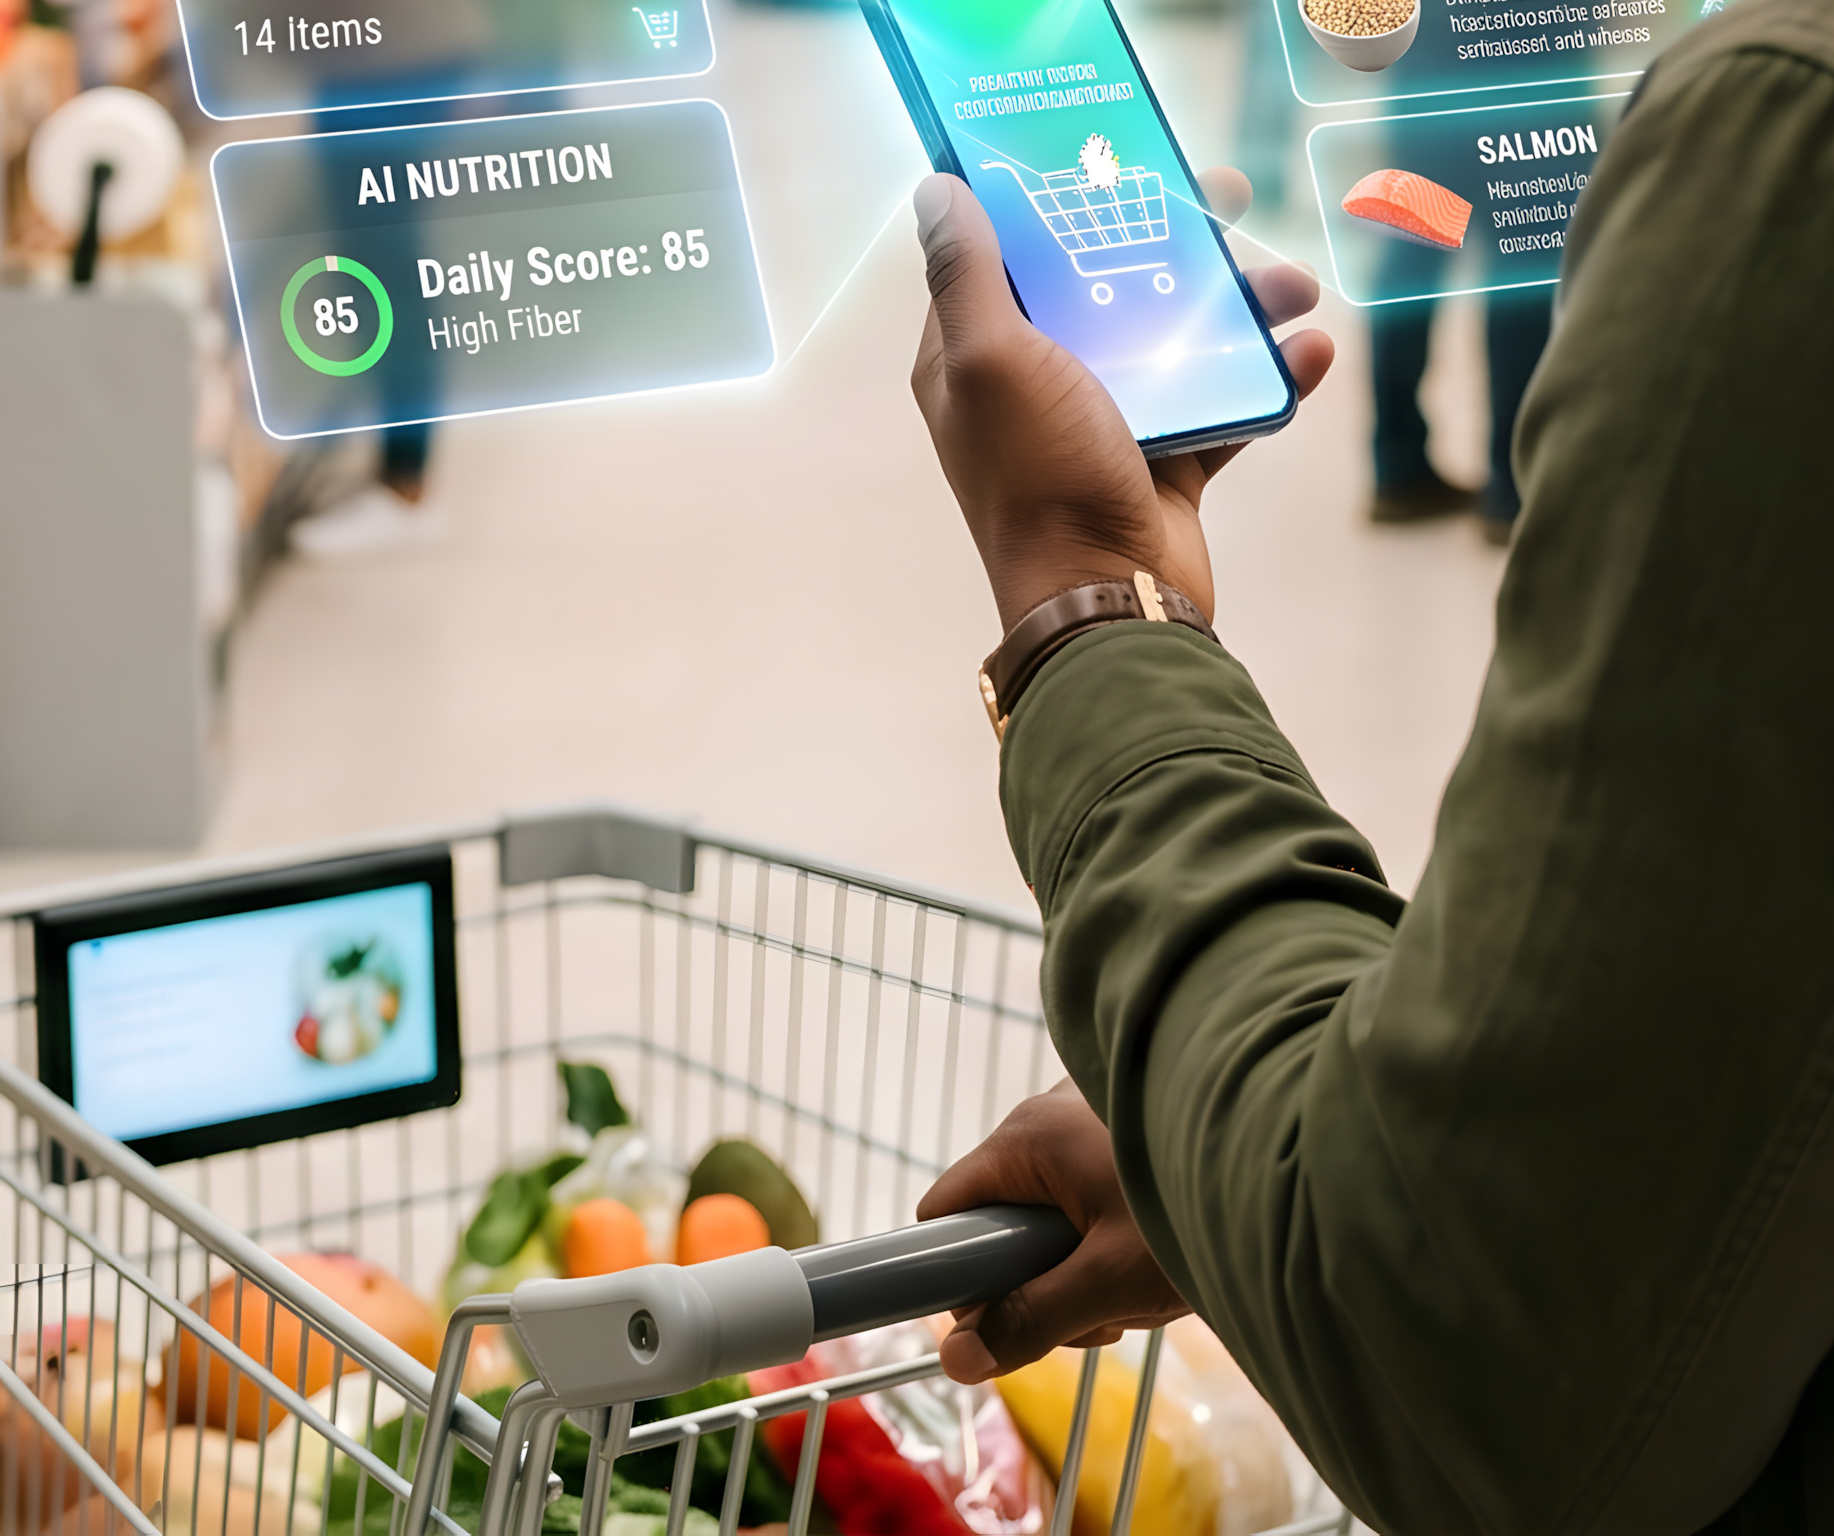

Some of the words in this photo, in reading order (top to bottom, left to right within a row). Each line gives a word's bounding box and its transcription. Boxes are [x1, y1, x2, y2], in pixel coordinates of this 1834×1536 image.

[234, 18, 276, 56] 14
[1477, 124, 1598, 164] SALMON
[357, 165, 396, 206] AI
[405, 142, 613, 201] NUTRITION
[417, 252, 514, 301] Daily
[528, 240, 652, 288] Score:
[660, 228, 710, 272] 85
[312, 295, 359, 337] 85
[427, 311, 499, 355] High
[506, 302, 582, 341] Fiber
